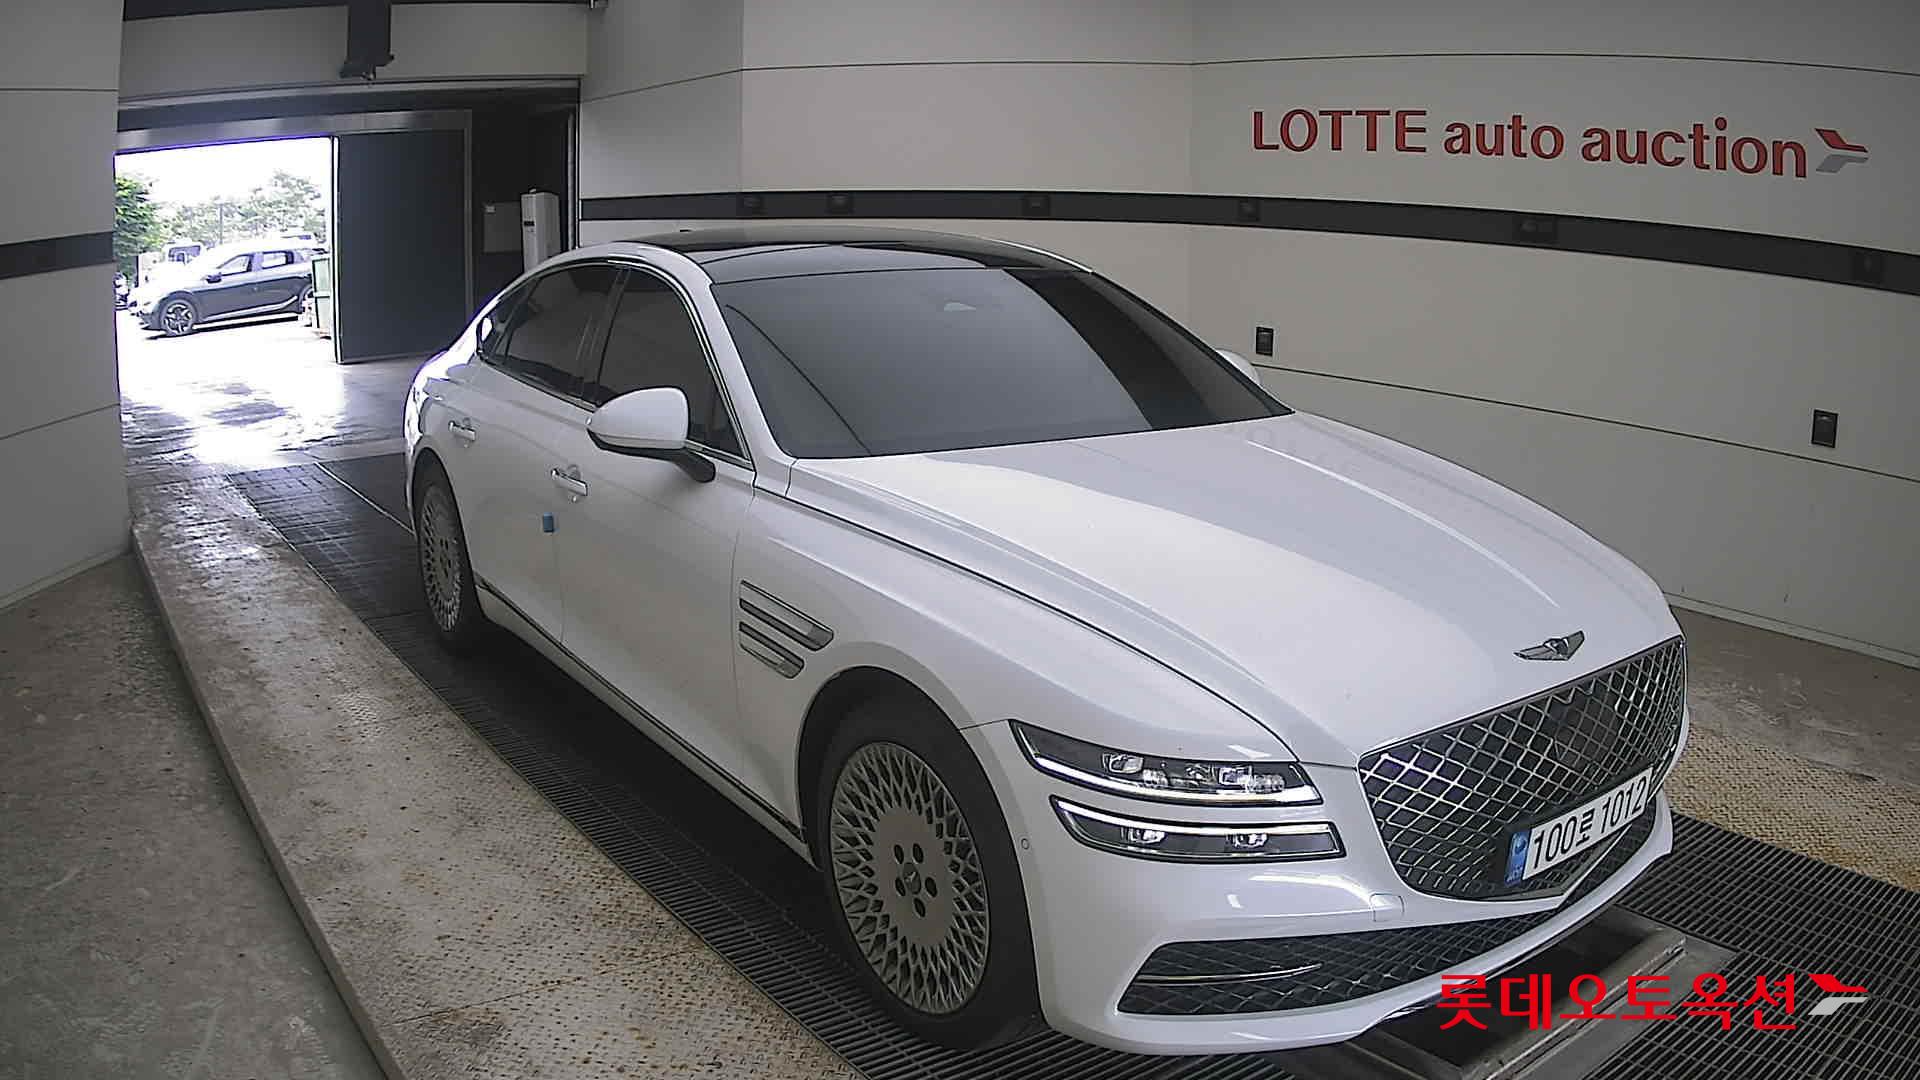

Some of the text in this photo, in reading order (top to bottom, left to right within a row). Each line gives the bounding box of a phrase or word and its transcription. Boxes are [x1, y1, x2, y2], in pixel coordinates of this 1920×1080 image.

[1252, 109, 1808, 178] LOTTE auto auction
[1533, 776, 1647, 869] 100로 1012
